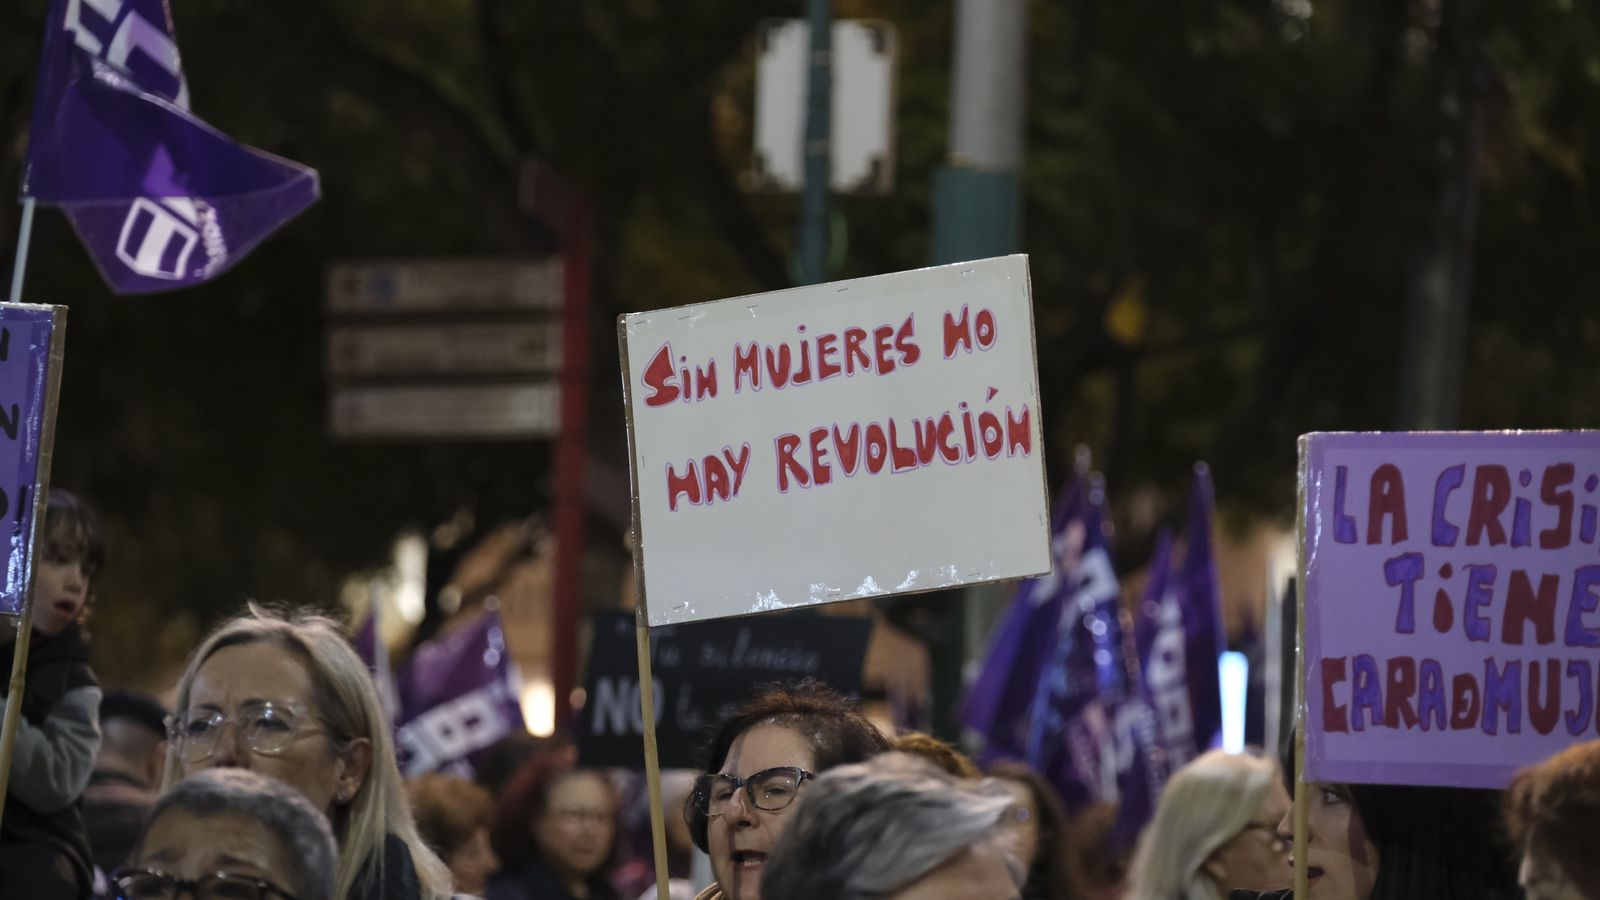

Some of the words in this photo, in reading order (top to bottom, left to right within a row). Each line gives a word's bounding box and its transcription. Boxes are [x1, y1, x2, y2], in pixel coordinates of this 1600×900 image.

[943, 303, 997, 361] NO
[666, 442, 751, 512] HAY
[1333, 463, 1409, 545] LA
[591, 676, 664, 736] NO
[1481, 656, 1600, 736] MUJ
